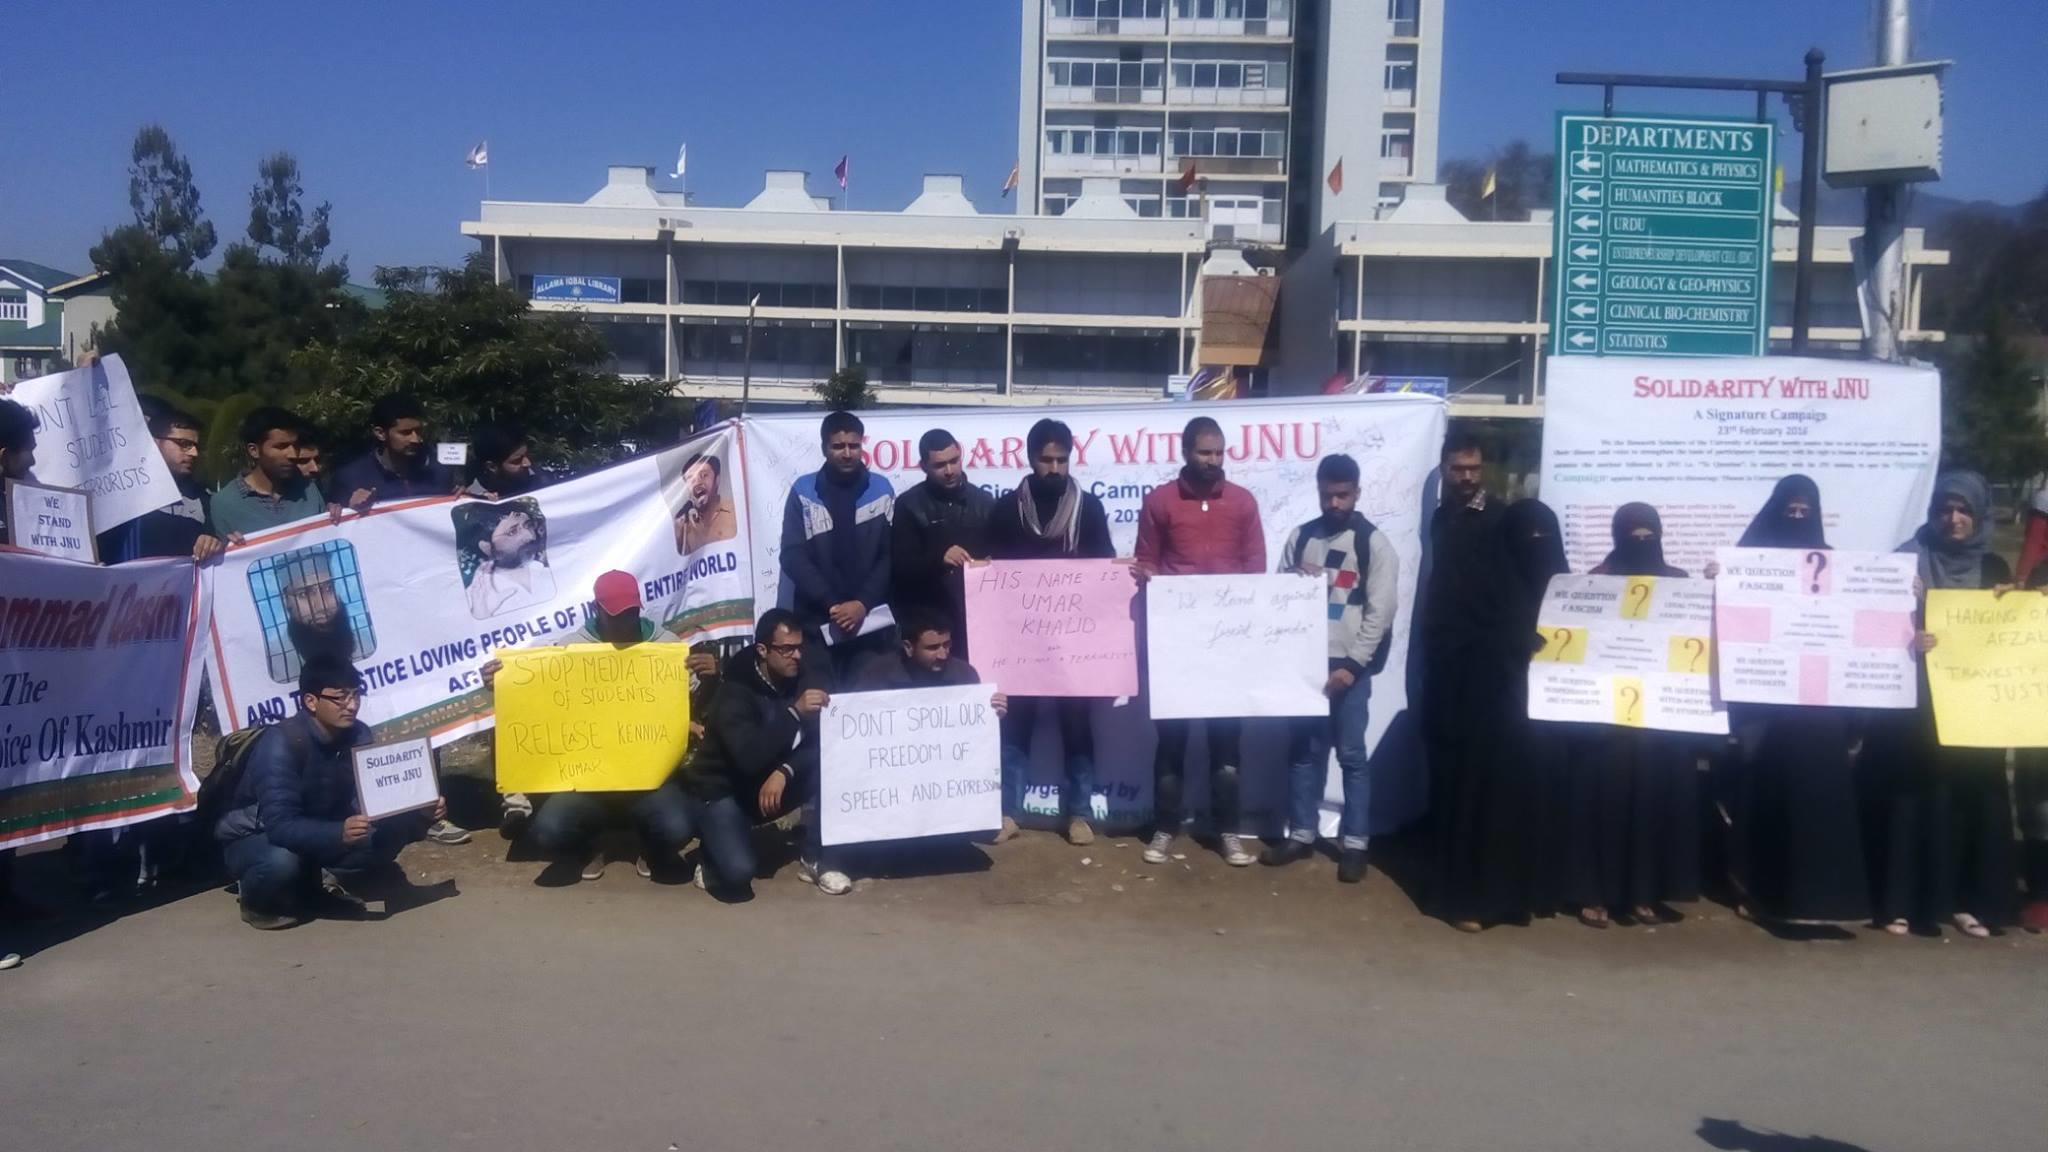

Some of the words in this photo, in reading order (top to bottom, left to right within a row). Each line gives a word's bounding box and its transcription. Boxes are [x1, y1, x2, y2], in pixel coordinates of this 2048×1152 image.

[1582, 124, 1753, 151] DEPARTMENTS
[1615, 159, 1697, 175] MATHEMATICS
[1700, 164, 1709, 176] &
[1712, 163, 1757, 178] PHYSICS
[1615, 188, 1684, 204] HUMANITIES
[1686, 191, 1722, 205] BLOCK
[1614, 217, 1646, 231] URDU
[588, 279, 616, 296] LIBRARY
[1611, 275, 1665, 290] GEOLOGY
[1667, 280, 1676, 291] &
[1679, 278, 1750, 293] GEO-PHYSICS
[1609, 304, 1661, 320] CLINICAL
[1664, 306, 1749, 322] BIO-CHEMISTRY
[1608, 334, 1667, 348] STATISTICS
[1634, 376, 1776, 399] SOLIDARITY
[1779, 376, 1828, 399] WITH
[1832, 378, 1870, 399] JNU
[1693, 409, 1703, 420] A
[1706, 408, 1767, 424] Signature
[1770, 409, 1828, 425] Campaign
[1739, 426, 1783, 437] February
[1108, 427, 1184, 465] WIT
[1227, 422, 1321, 462] JNU
[44, 496, 59, 509] WE
[38, 514, 71, 528] STAND
[30, 533, 56, 547] WITH
[60, 535, 81, 549] JNU
[979, 571, 1022, 592] HIS
[1036, 572, 1083, 588] NAME
[1100, 571, 1119, 582] IS
[1727, 567, 1742, 576] WE
[1744, 567, 1796, 577] QUESTION
[1021, 592, 1084, 613] UMAR
[1571, 591, 1617, 601] QUESTION
[1020, 616, 1096, 637] KHALID
[1945, 607, 2017, 627] HANGING
[247, 697, 286, 726] AND
[410, 638, 477, 676] LOVING
[480, 617, 550, 654] PEOPLE
[553, 606, 577, 628] OF
[644, 568, 688, 602] ENTIRE
[688, 552, 737, 581] WORLD
[513, 655, 574, 685] STOP
[582, 655, 639, 684] MEDIA
[643, 654, 689, 685] TRAIL
[1, 672, 48, 706] The
[583, 685, 656, 705] STUDENTS
[907, 706, 955, 732] SPOIL
[959, 703, 986, 726] OUR
[38, 716, 69, 762] Of
[73, 708, 173, 757] Kashmir
[617, 721, 672, 745] KENNIYA
[366, 745, 424, 769] SOLIDARITY
[868, 743, 942, 769] FREEDOM
[952, 742, 970, 761] OF
[375, 774, 400, 788] WITH
[402, 767, 422, 782] JNU
[558, 759, 604, 782] KUMAR
[840, 787, 899, 813] SPEECH
[911, 782, 942, 803] AND
